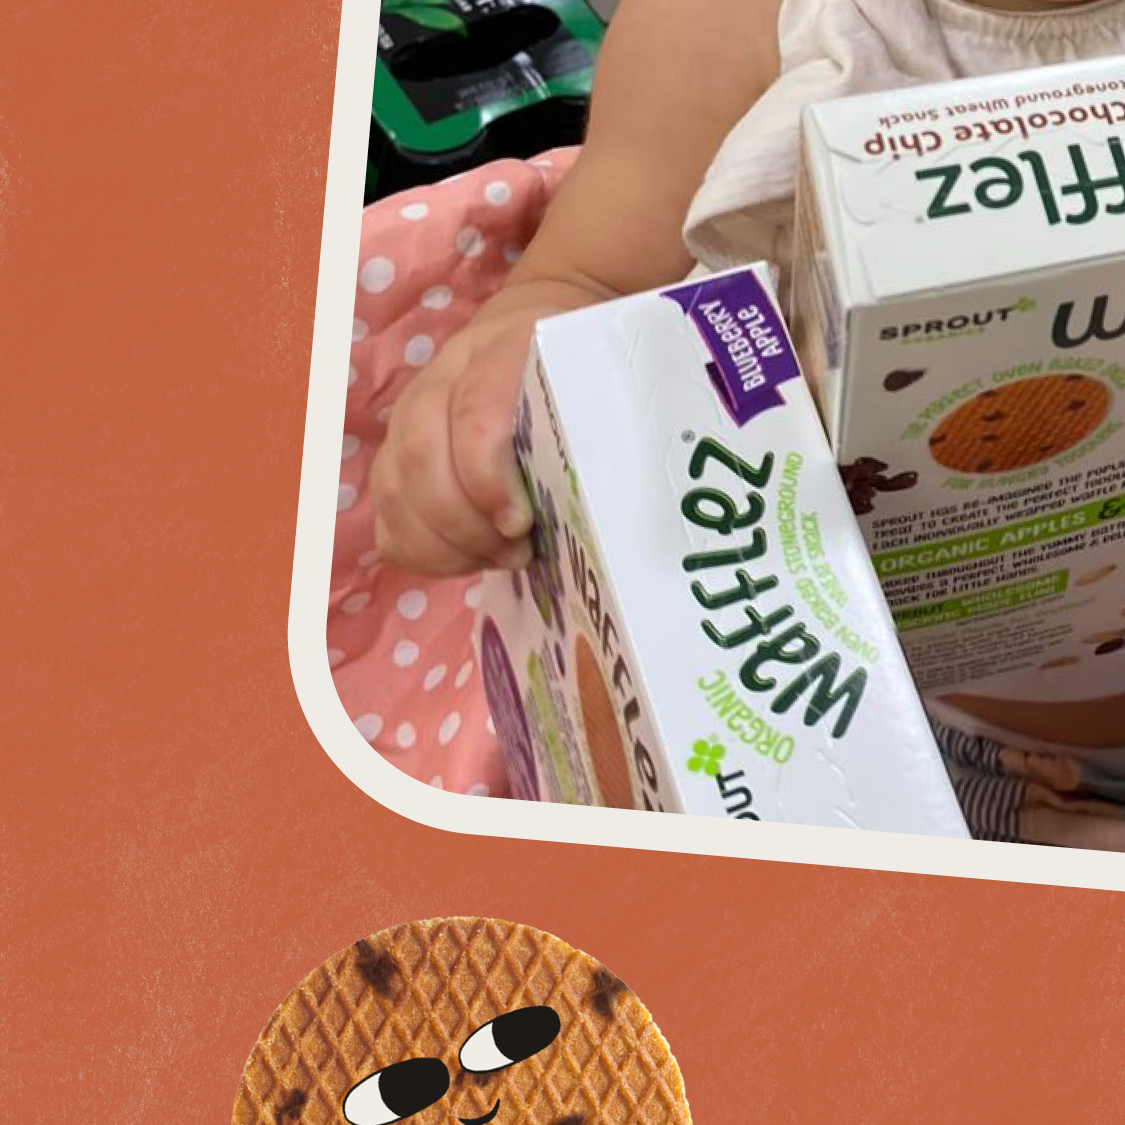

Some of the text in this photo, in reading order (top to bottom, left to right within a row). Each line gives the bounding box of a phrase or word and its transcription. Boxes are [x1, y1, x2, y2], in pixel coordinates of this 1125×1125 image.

[879, 105, 942, 128] Snack
[952, 94, 1010, 117] Wheat
[864, 130, 943, 163] Chip
[880, 307, 1013, 340] SPROUT
[880, 537, 990, 572] ORGANIC
[1001, 511, 1086, 545] APPLES
